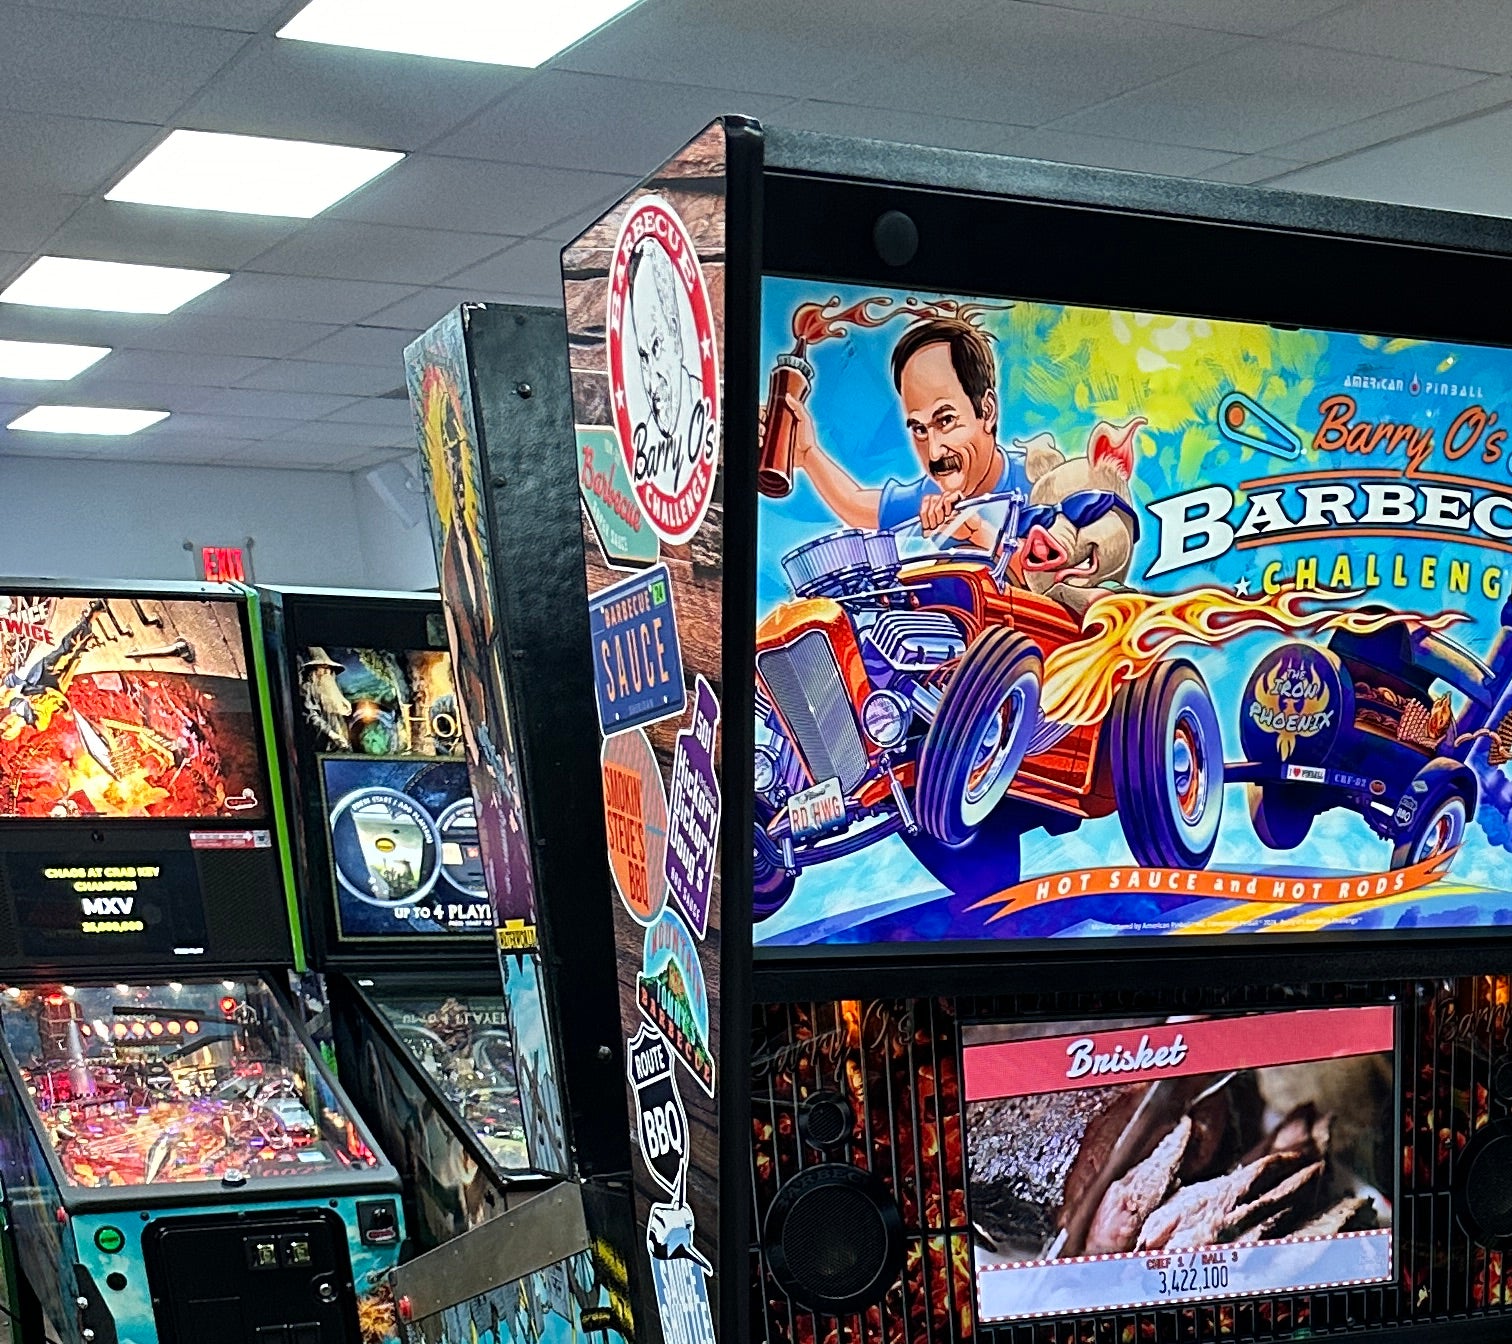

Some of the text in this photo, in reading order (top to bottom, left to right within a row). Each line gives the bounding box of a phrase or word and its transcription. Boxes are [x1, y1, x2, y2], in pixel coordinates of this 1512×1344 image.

[609, 210, 698, 333] BARBECUE
[1343, 375, 1483, 399] AMERICAN PINBALL
[633, 398, 716, 493] Barry O's
[1312, 395, 1509, 480] Barry O's
[643, 463, 707, 528] CHALLENGE
[202, 547, 245, 582] EXIT
[604, 590, 651, 629] BARBECUE
[601, 617, 670, 703] SAUCE
[1287, 668, 1307, 681] THE
[1270, 679, 1321, 699] IRON
[1249, 702, 1335, 733] PHOENIX
[677, 745, 717, 841] Hickory
[606, 809, 646, 863] STEVE'S
[672, 782, 714, 874] Dickory
[792, 806, 808, 832] RD
[44, 867, 87, 879] CHAOS
[88, 868, 103, 878] AT
[669, 816, 705, 894] Doug's
[81, 897, 134, 916] MXV
[627, 861, 651, 911] BBQ
[682, 881, 702, 926] SAUCE
[1034, 871, 1406, 900] HOT SAUCE and HOT RODS
[395, 904, 445, 919] UP TO 4
[651, 922, 702, 1014] MOUNTAIN
[640, 986, 711, 1084] BARBECUE
[1065, 1034, 1188, 1079] Brisket
[634, 1043, 666, 1081] ROUTE
[643, 1100, 683, 1159] BBQ
[659, 1258, 701, 1304] SAUCE
[1146, 1257, 1172, 1271] CHEF
[1201, 1255, 1226, 1268] BALL
[1158, 1267, 1230, 1295] 3,422,100
